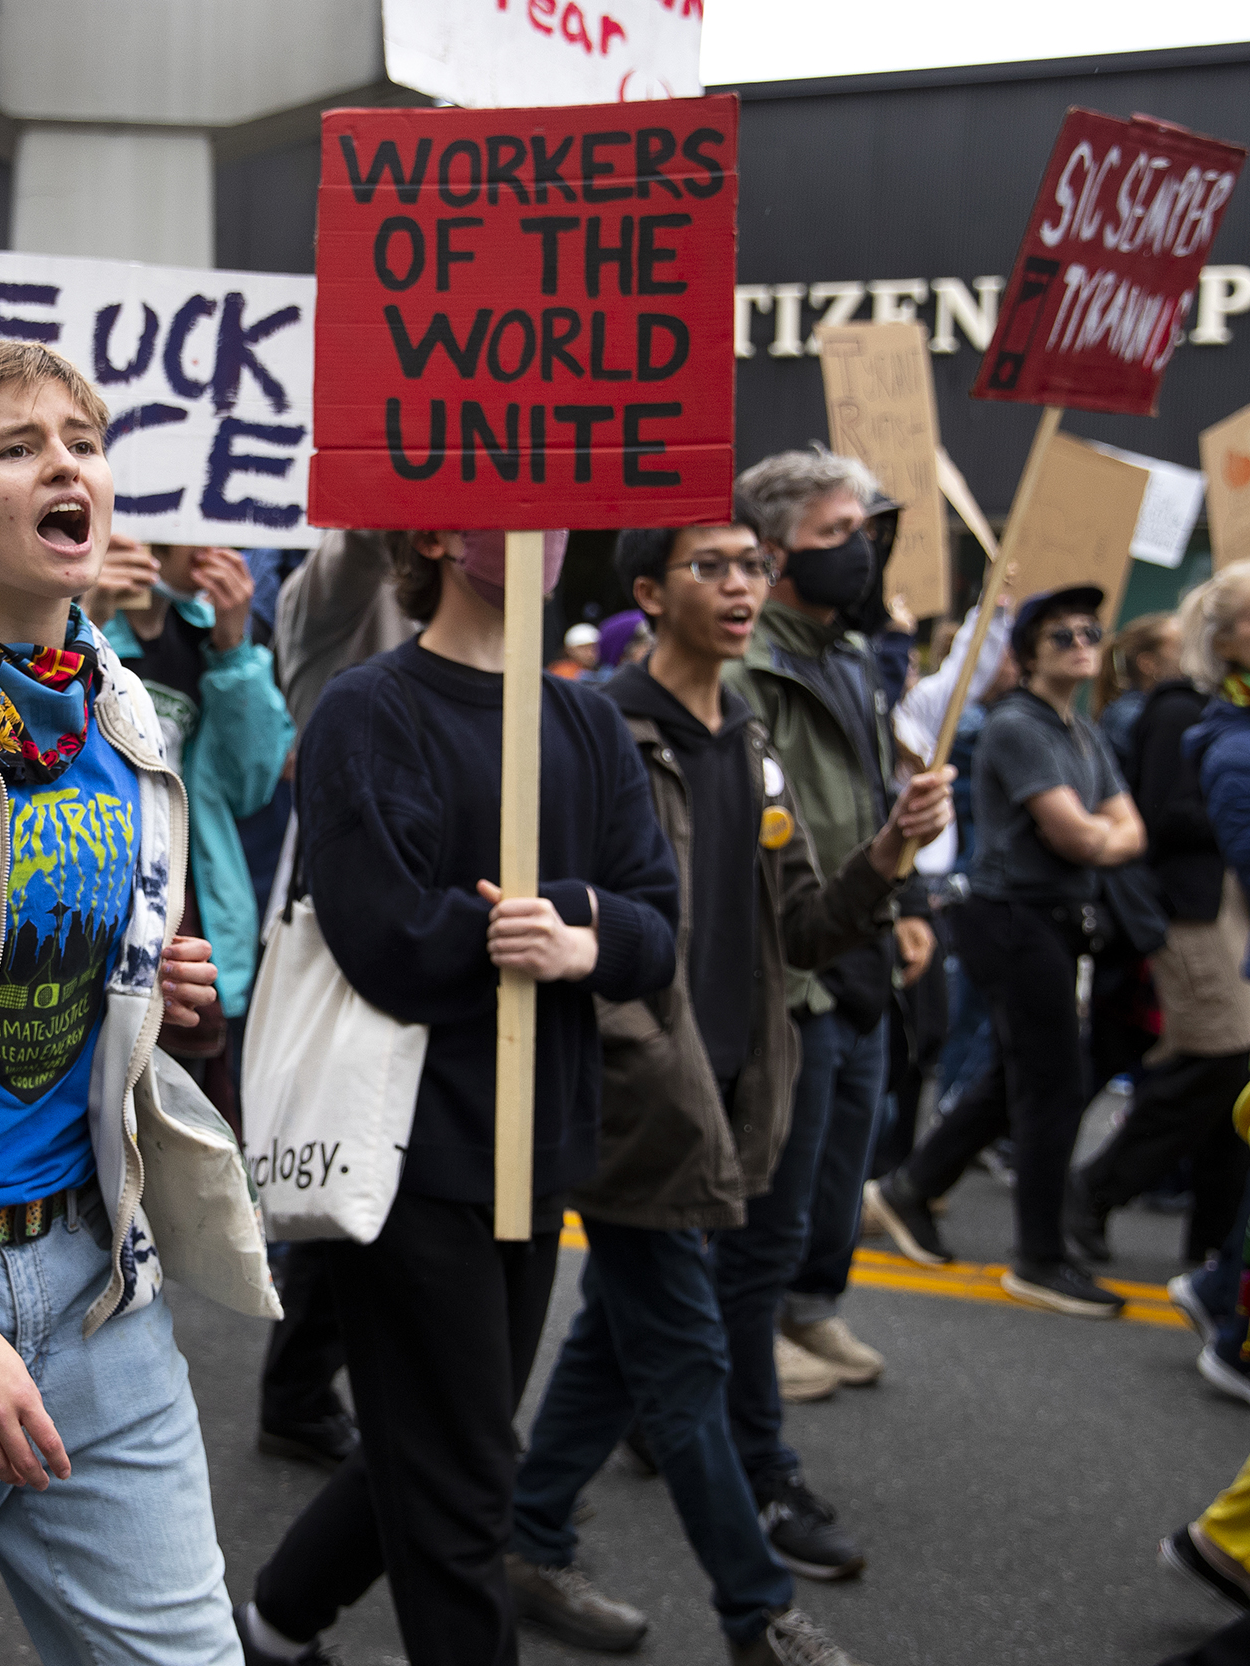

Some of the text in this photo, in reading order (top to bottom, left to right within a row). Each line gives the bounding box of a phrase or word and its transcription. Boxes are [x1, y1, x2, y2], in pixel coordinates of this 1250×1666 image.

[496, 0, 628, 55] ear
[338, 127, 726, 208] WORKERS
[1039, 138, 1236, 257] SIC SEMPER
[372, 213, 693, 299] OF THE
[382, 304, 691, 384] WORLD
[734, 276, 1007, 358] TIZEN
[104, 402, 307, 530] CE
[385, 397, 683, 488] UNITE
[39, 1024, 86, 1061] ENERGY
[45, 992, 91, 1038] JUSTICE
